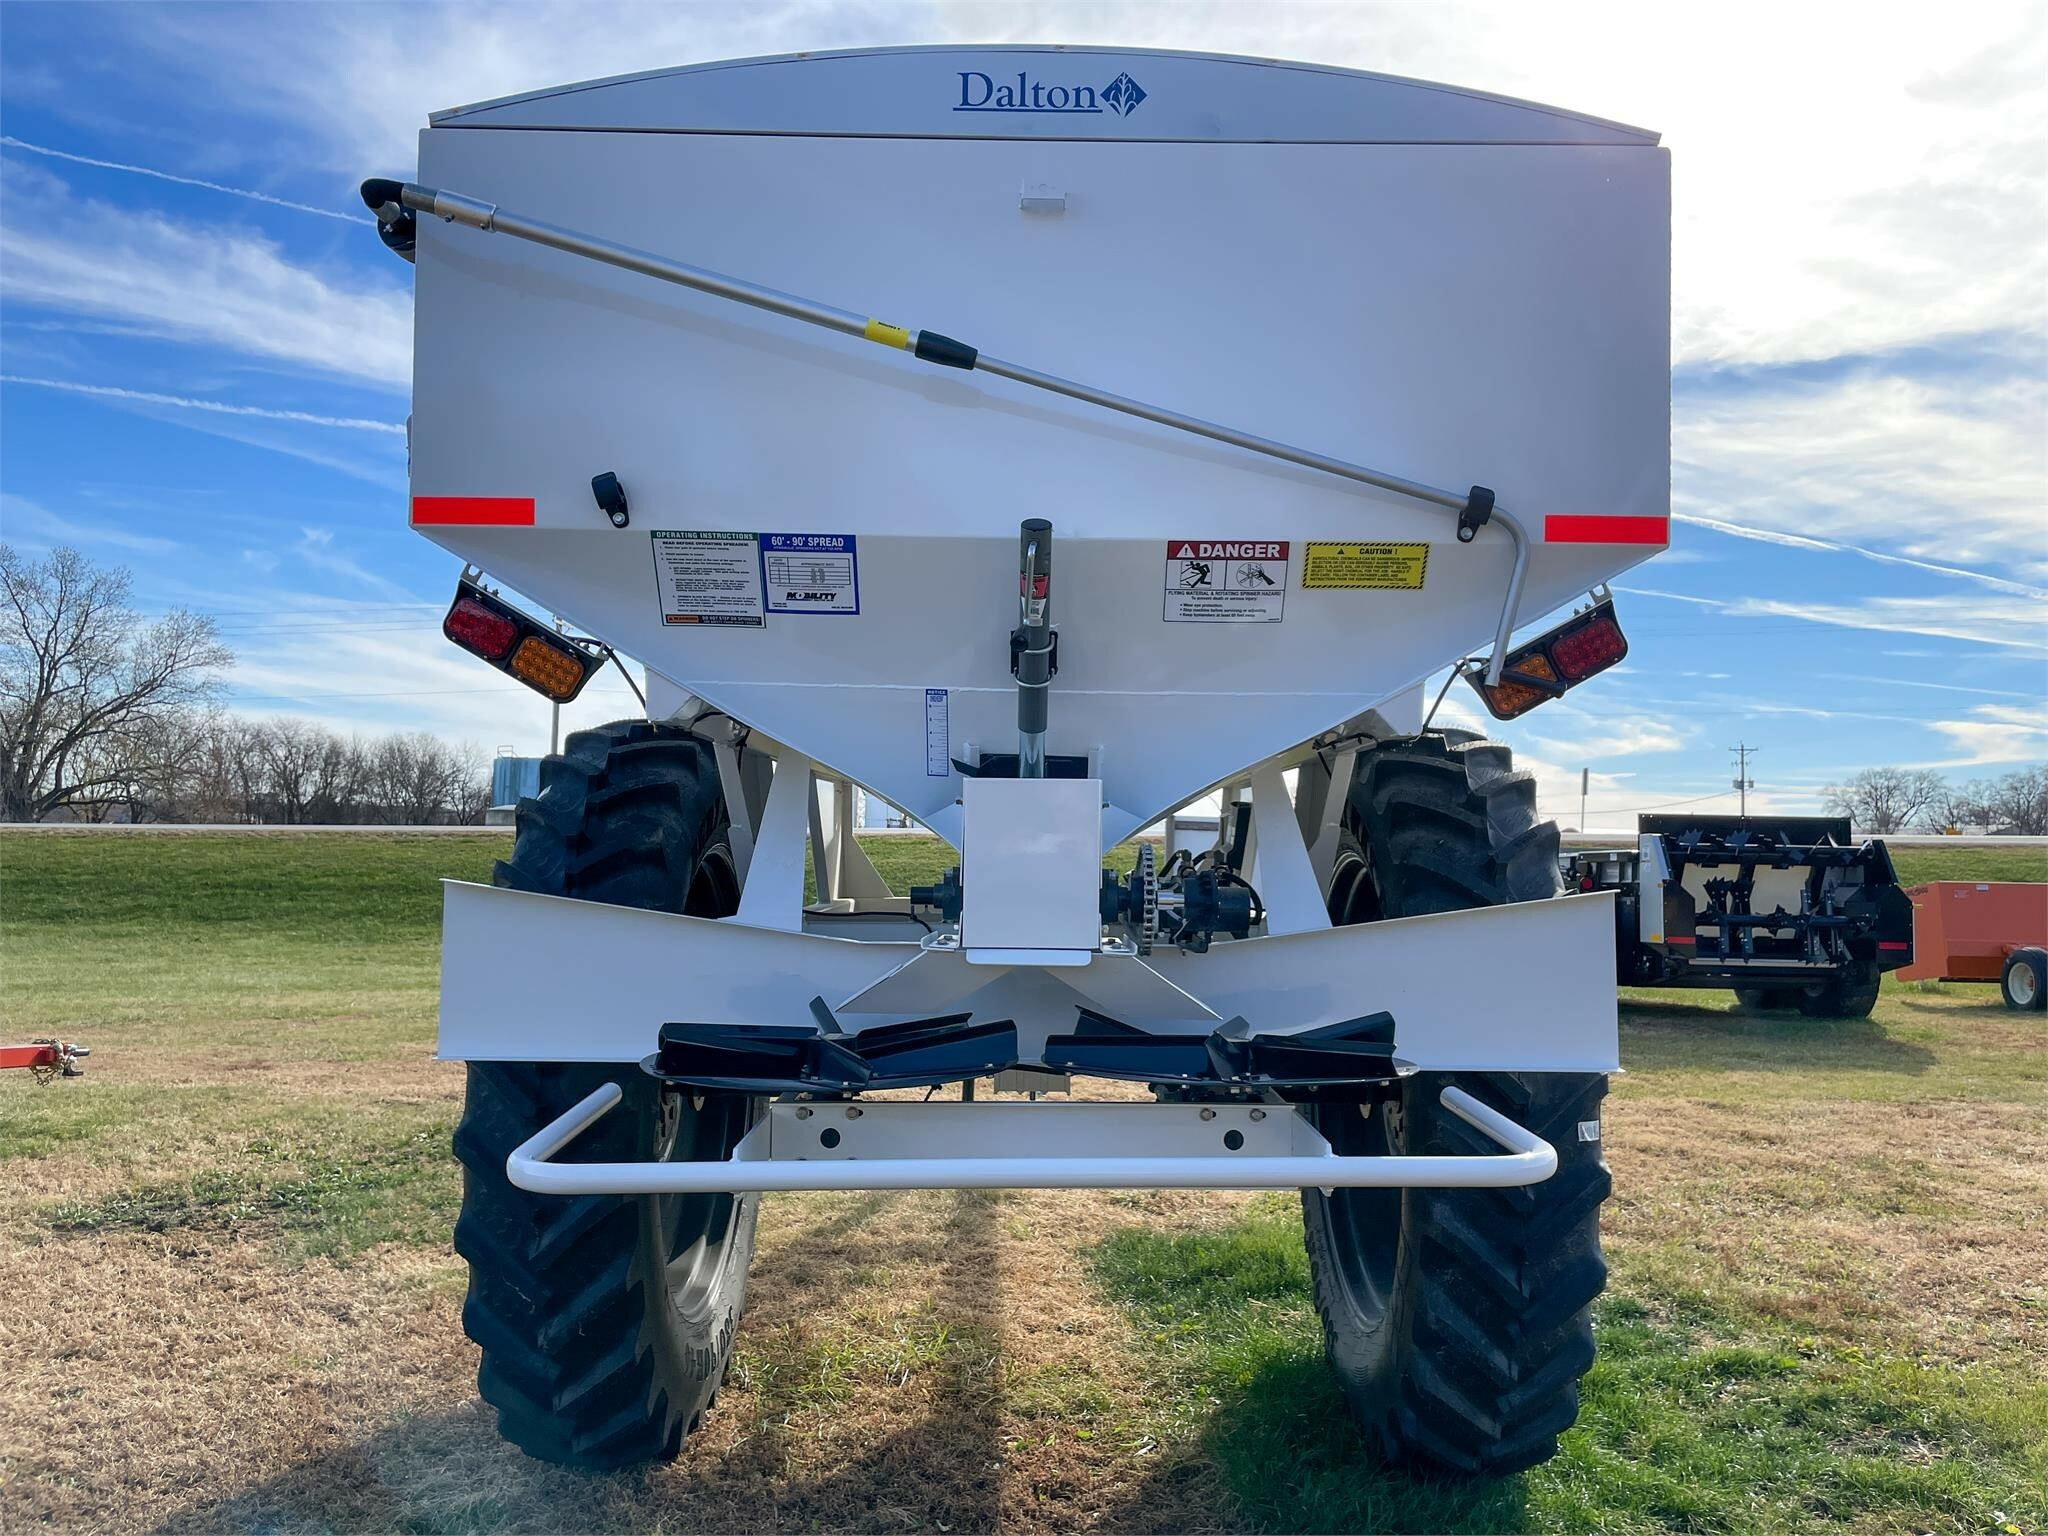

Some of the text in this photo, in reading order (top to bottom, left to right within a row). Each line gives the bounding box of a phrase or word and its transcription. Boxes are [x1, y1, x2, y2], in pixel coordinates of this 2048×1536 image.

[956, 71, 1099, 108] Dalton
[771, 536, 784, 546] 60'
[792, 537, 805, 546] 90'
[808, 537, 844, 546] SPREAD
[1200, 543, 1280, 558] DANGER
